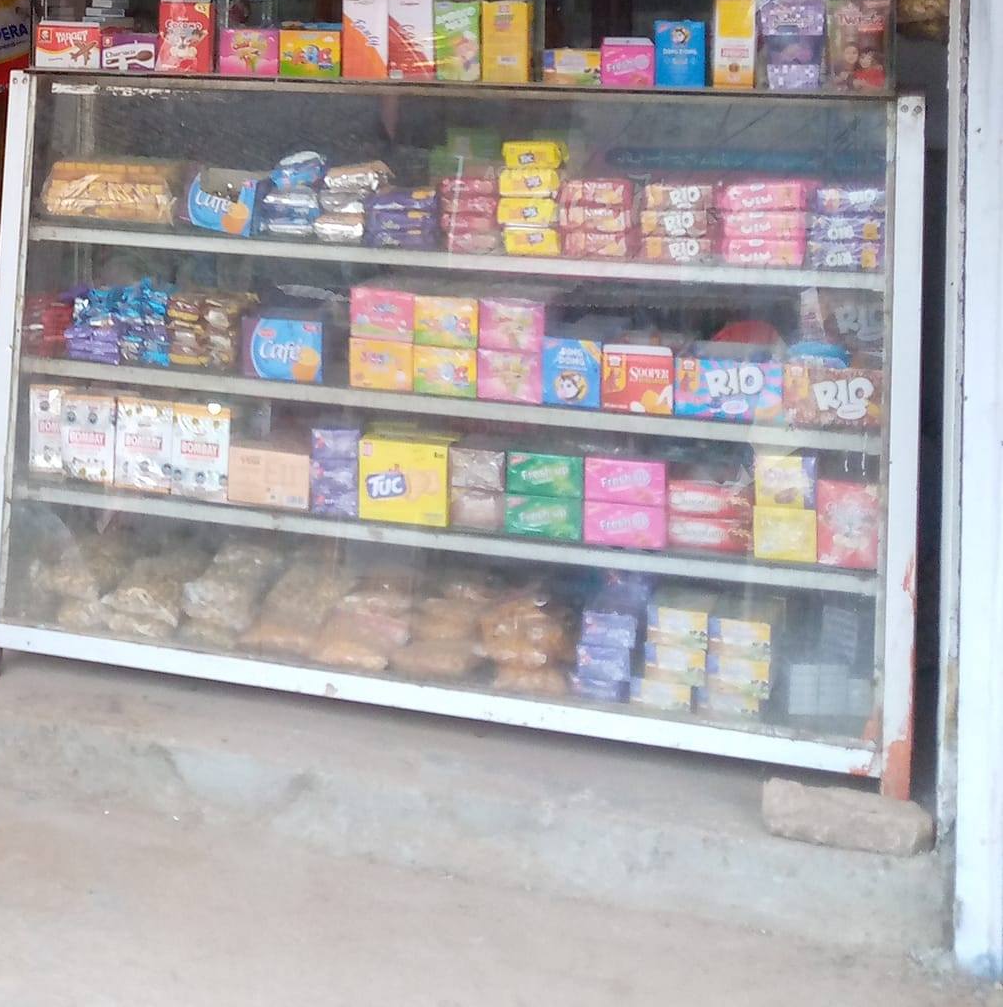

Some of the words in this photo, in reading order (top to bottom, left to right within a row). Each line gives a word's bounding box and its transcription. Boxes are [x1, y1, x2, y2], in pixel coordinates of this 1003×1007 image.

[55, 30, 88, 45] TARGET
[669, 240, 699, 257] RIO
[629, 367, 670, 382] SOOPER
[705, 366, 765, 398] RIO
[812, 377, 875, 411] RIO
[70, 432, 104, 445] BOMBAY
[126, 434, 161, 450] BOMBAY
[182, 441, 218, 457] BOMBAY
[368, 473, 404, 497] TUC
